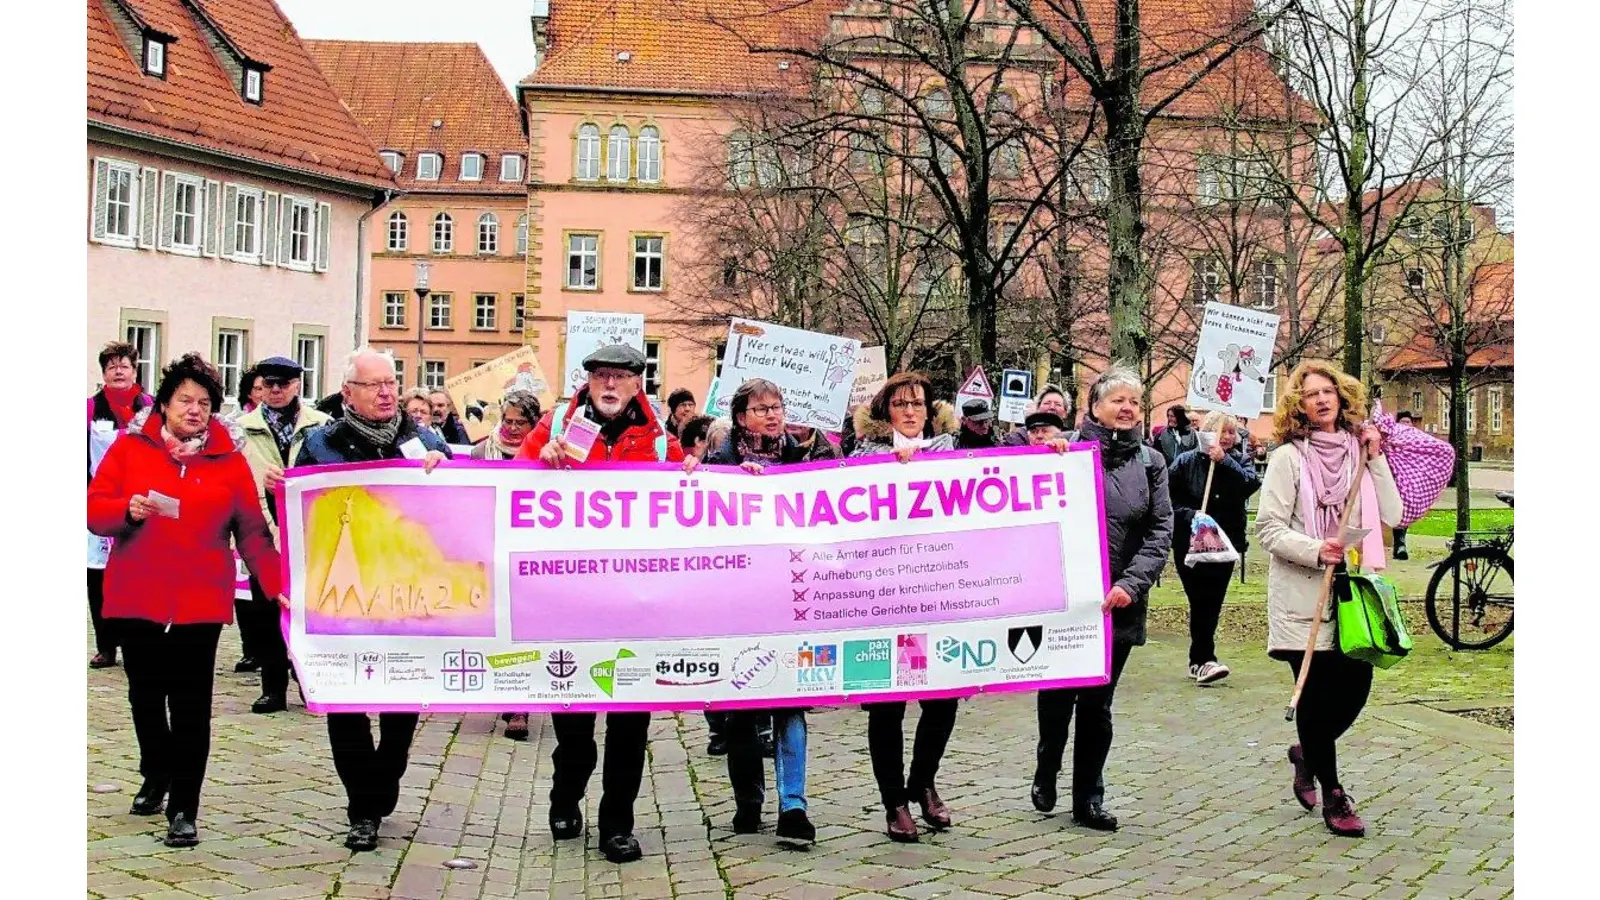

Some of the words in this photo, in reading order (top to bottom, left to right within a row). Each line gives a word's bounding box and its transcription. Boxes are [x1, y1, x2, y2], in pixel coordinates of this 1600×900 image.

[747, 337, 770, 353] Wer
[773, 344, 806, 358] etwas
[808, 350, 830, 364] will,
[743, 352, 776, 368] findet
[780, 356, 812, 375] Wege.
[790, 388, 811, 398] nicht
[510, 490, 564, 529] ES
[575, 490, 638, 529] IST
[648, 479, 763, 529] FÜNF
[774, 482, 898, 528] NACH
[907, 466, 1067, 520] ZWÖLF!
[811, 551, 834, 562] Alle
[836, 546, 869, 561] Ämter
[871, 544, 897, 557] auch
[899, 542, 914, 555] für
[916, 541, 954, 554] Frauen
[518, 559, 609, 576] ERNEUERT
[612, 557, 681, 574] UNSERE
[683, 554, 752, 572] KIRCHE:
[812, 566, 873, 582] Aufhebung
[875, 565, 896, 577] des
[812, 587, 876, 602] Anpassung
[878, 585, 897, 597] der
[898, 580, 956, 595] kirchlichen
[957, 573, 1023, 590] Sexualmoral
[813, 605, 869, 621] Staatliche
[871, 601, 919, 617] Gerichte
[920, 601, 938, 613] bei
[939, 596, 1001, 612] Missbrauch
[855, 649, 890, 662] christi
[869, 640, 890, 652] pax
[450, 656, 458, 667] K
[468, 656, 478, 667] D
[672, 658, 720, 677] dpsg
[731, 649, 776, 690] Kirche
[450, 674, 458, 686] F
[469, 675, 478, 686] B
[797, 667, 836, 683] KKV
[550, 680, 574, 691] SkF
